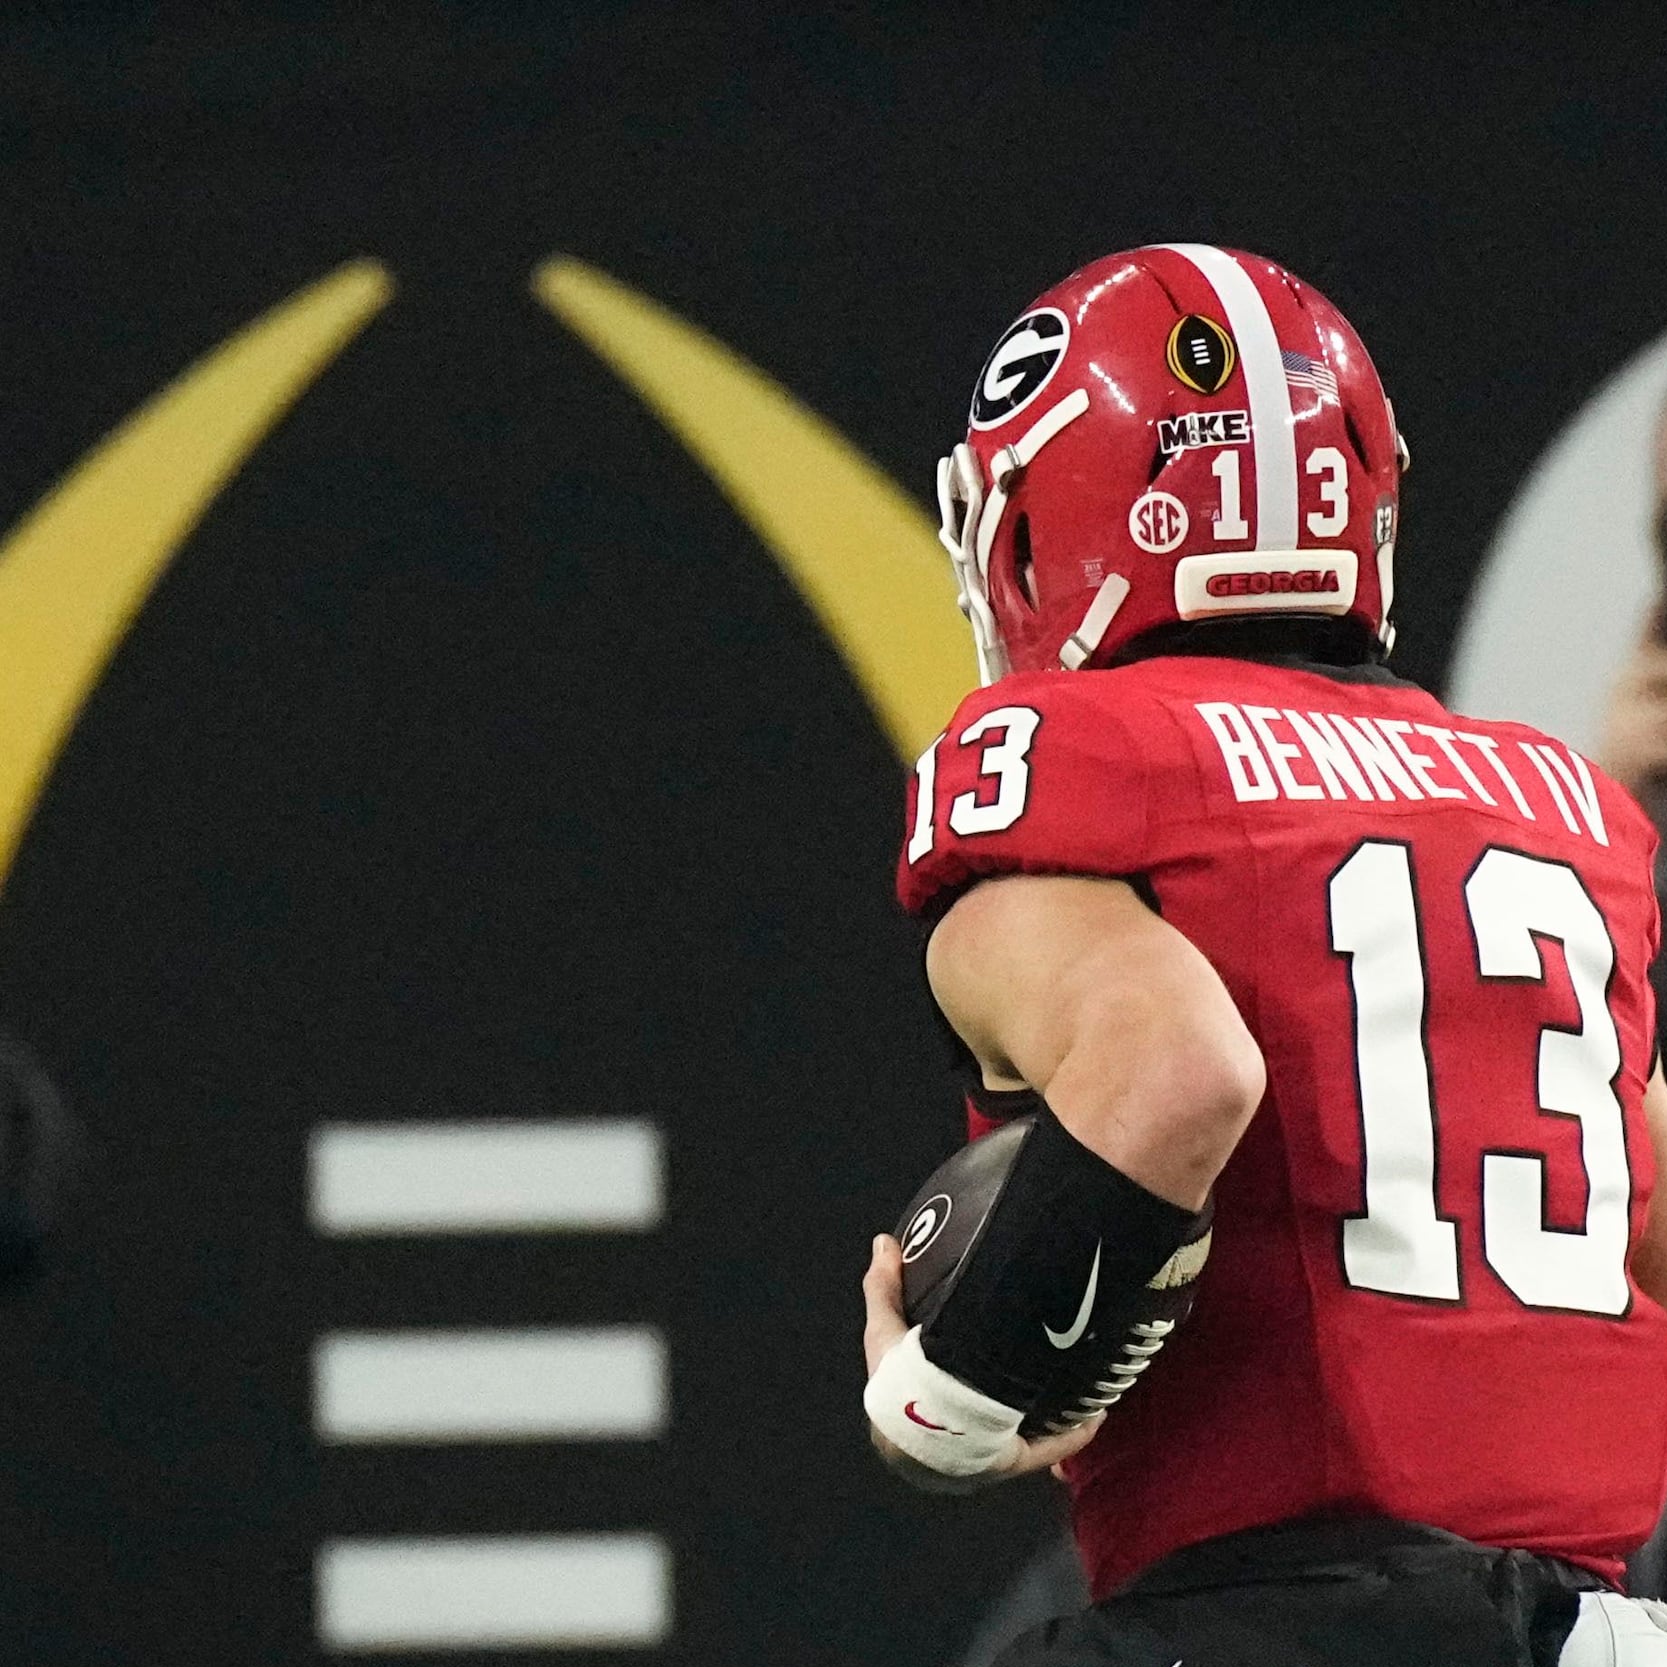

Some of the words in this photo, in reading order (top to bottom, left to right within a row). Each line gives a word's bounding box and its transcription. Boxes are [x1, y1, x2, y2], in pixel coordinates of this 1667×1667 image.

[1136, 499, 1181, 547] SEC
[1206, 570, 1340, 598] GEORGIA
[907, 705, 1042, 866] 13
[1194, 702, 1536, 821] BENNETT
[1517, 742, 1610, 847] IV
[1329, 842, 1633, 1316] 13
